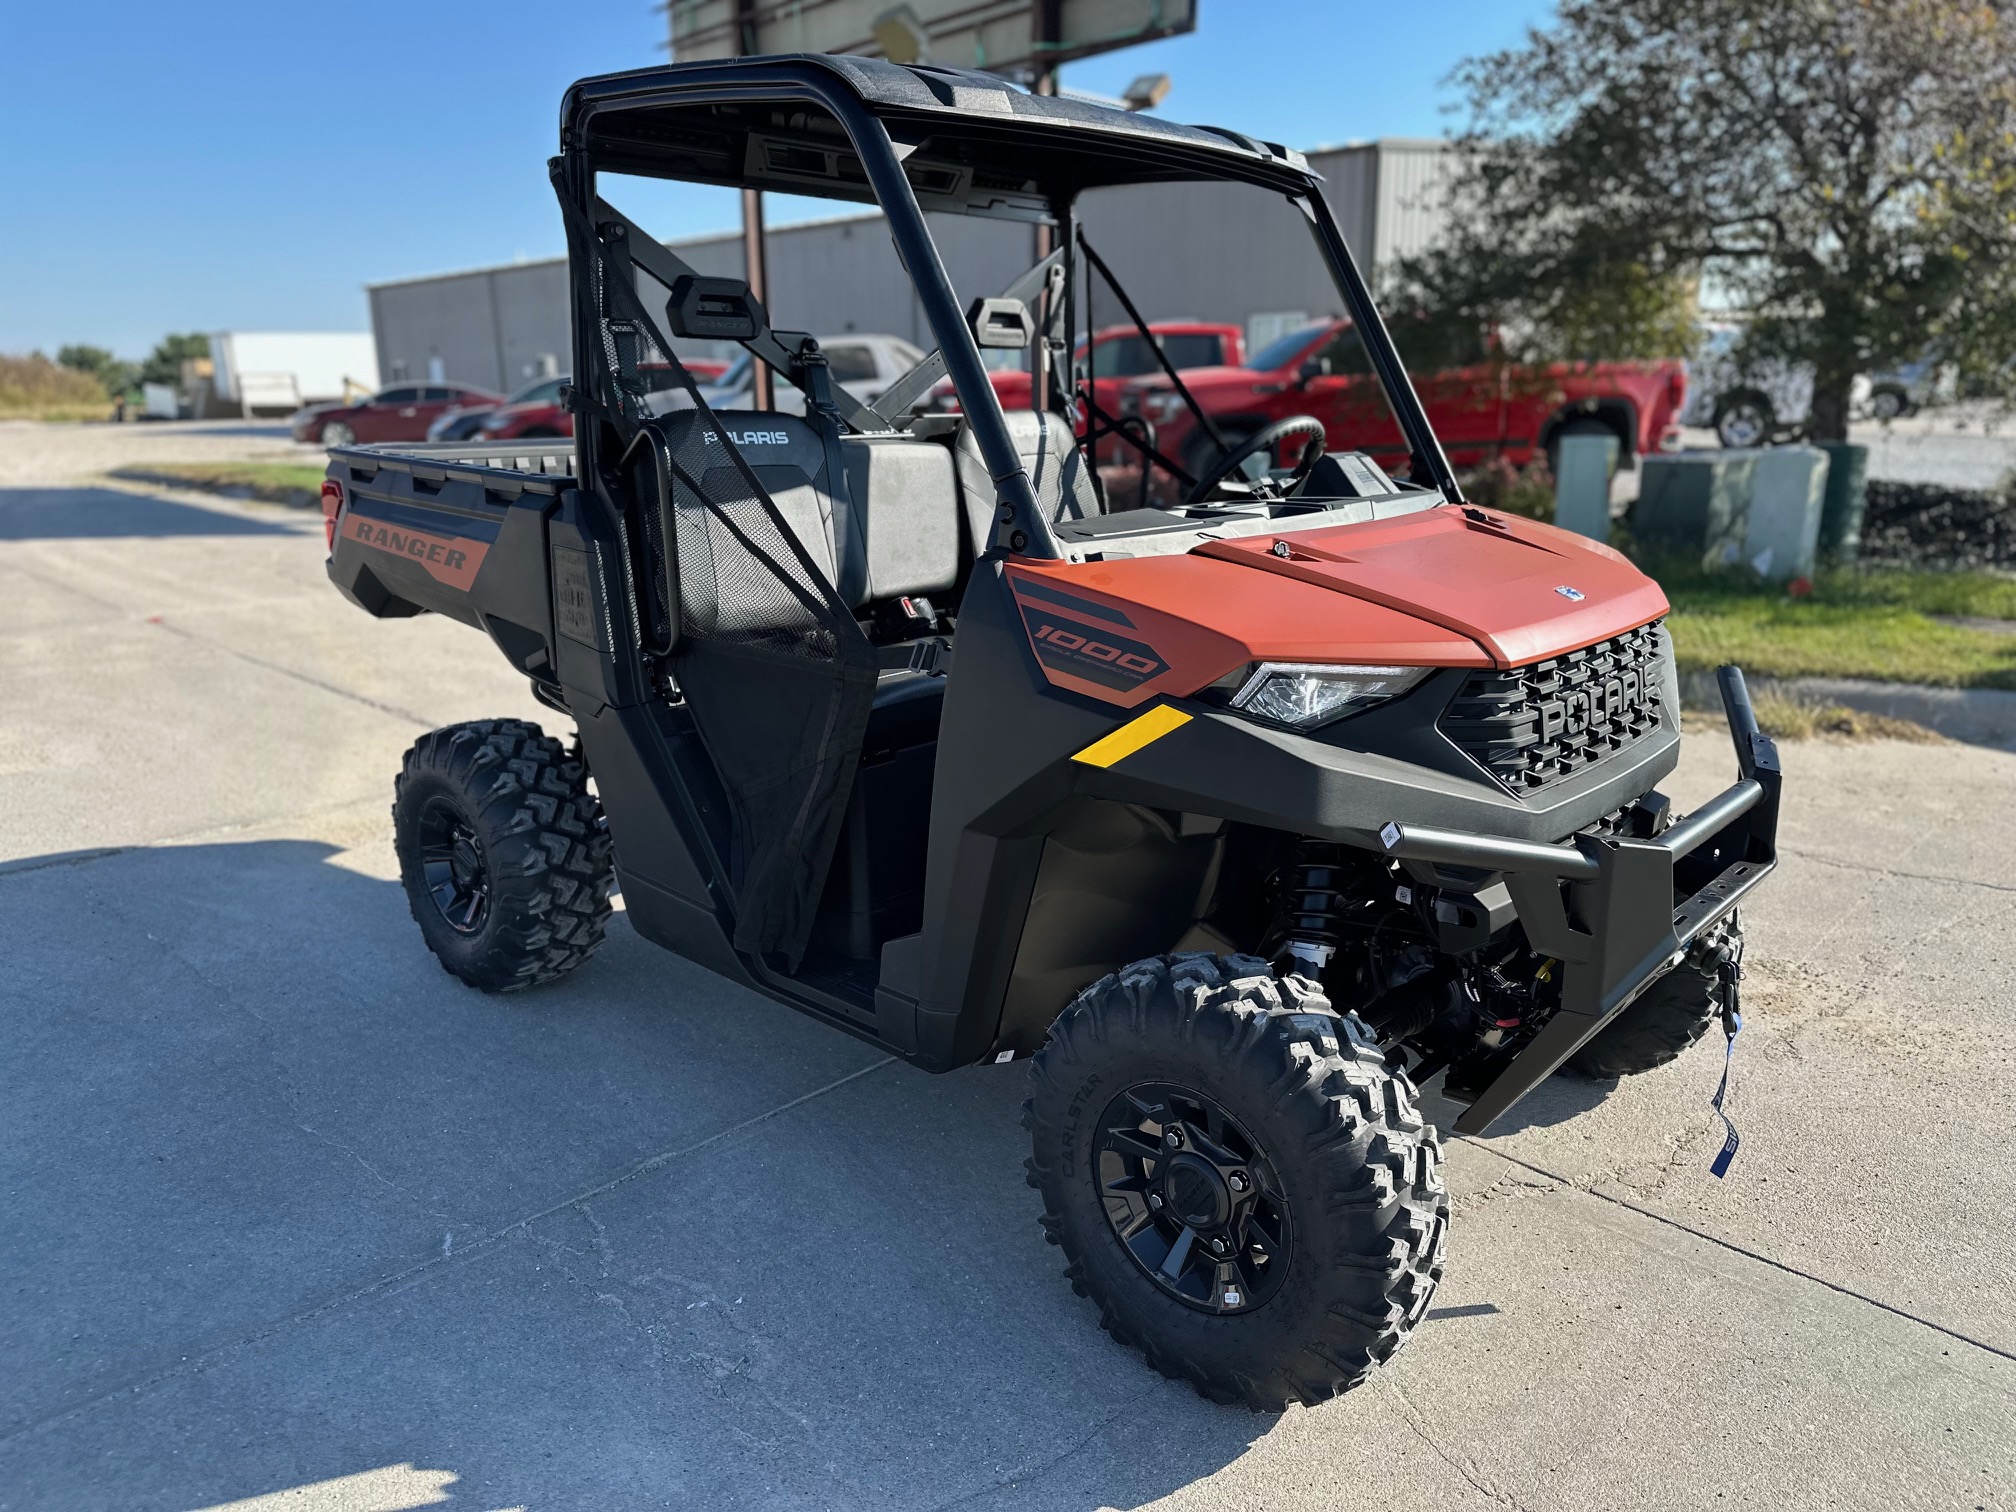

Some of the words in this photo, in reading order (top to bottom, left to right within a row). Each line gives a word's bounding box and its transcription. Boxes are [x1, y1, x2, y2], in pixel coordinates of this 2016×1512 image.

[356, 522, 467, 570] RANGER
[1034, 624, 1159, 674] 1000
[1541, 658, 1665, 744] POLARIS
[1062, 1073, 1103, 1178] CARLSTAR
